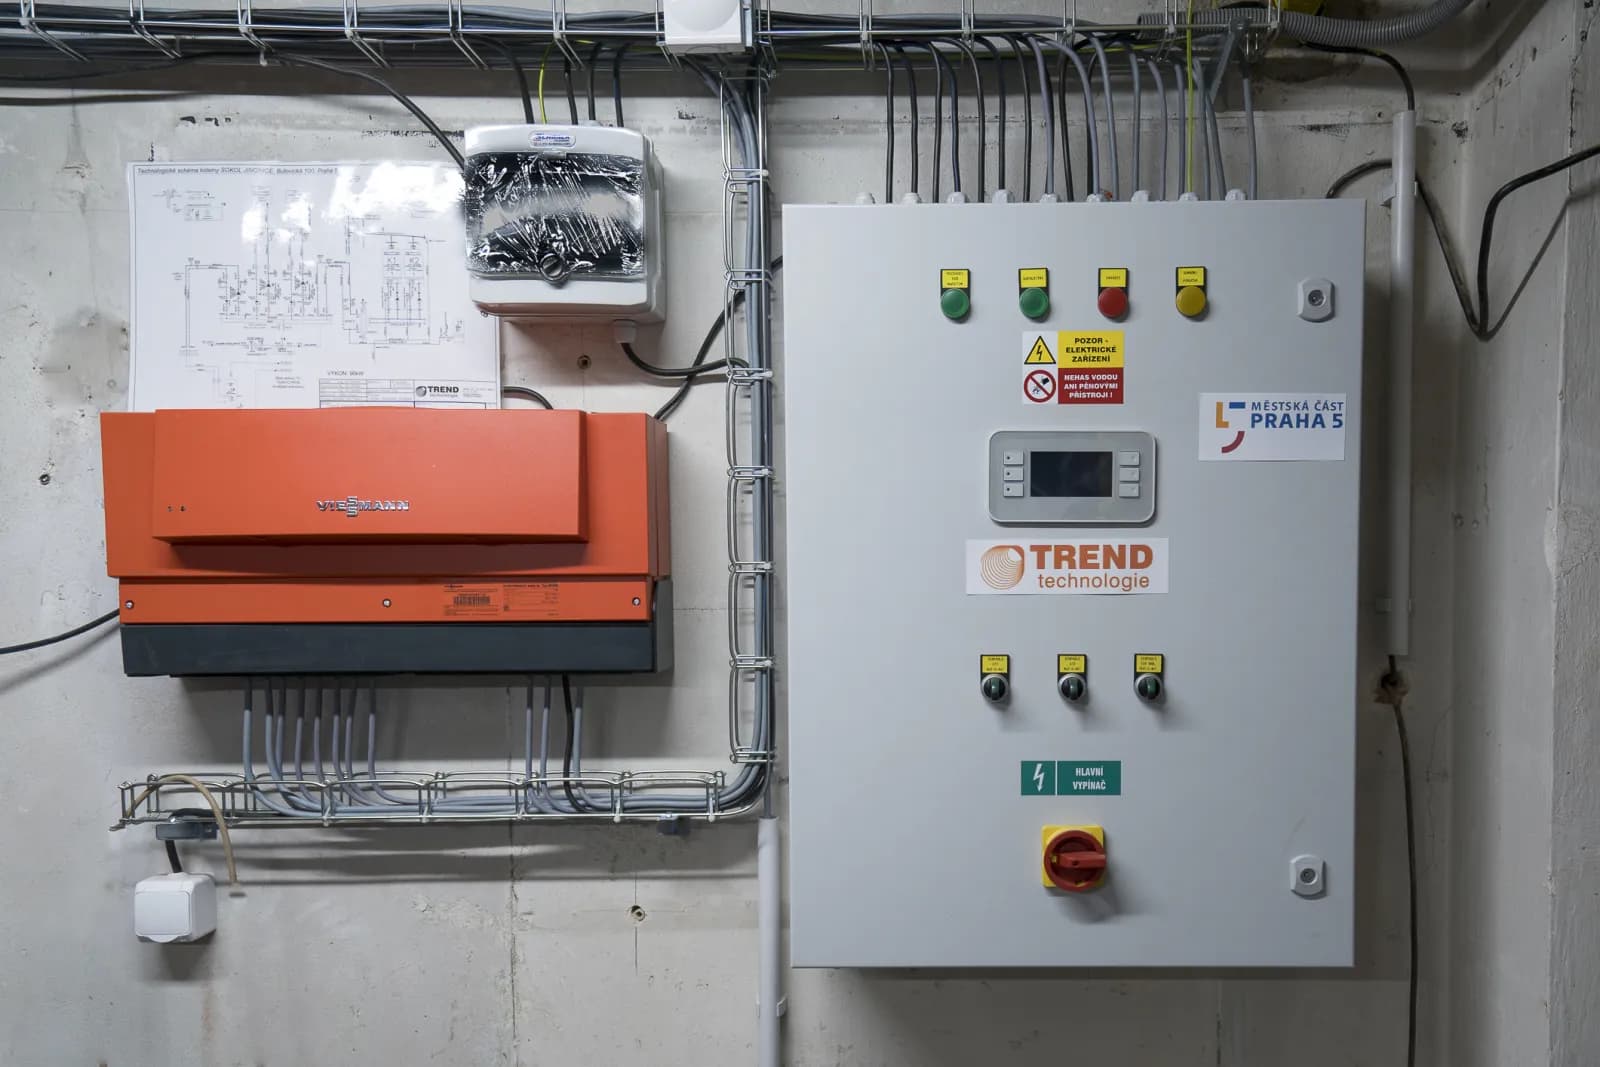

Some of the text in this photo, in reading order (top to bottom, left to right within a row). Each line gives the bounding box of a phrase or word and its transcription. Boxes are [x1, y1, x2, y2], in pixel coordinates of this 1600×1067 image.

[1065, 345, 1117, 354] ELEKTRICKÉ
[1071, 354, 1111, 363] ZAŘÍZENÍ
[427, 385, 459, 394] TREND
[1078, 381, 1118, 390] PĚNOVÝMI
[1068, 390, 1108, 399] PŘÍSTROJI
[1251, 400, 1344, 411] MĚSTSKÁ ČÁST
[1250, 412, 1344, 429] PRAHA 5
[315, 495, 411, 518] VIESSMANN
[1029, 544, 1154, 570] TREND
[1037, 573, 1150, 591] technologie
[1075, 765, 1104, 777] HLAVNÍ
[1072, 778, 1106, 790] VYPÍNAČ
